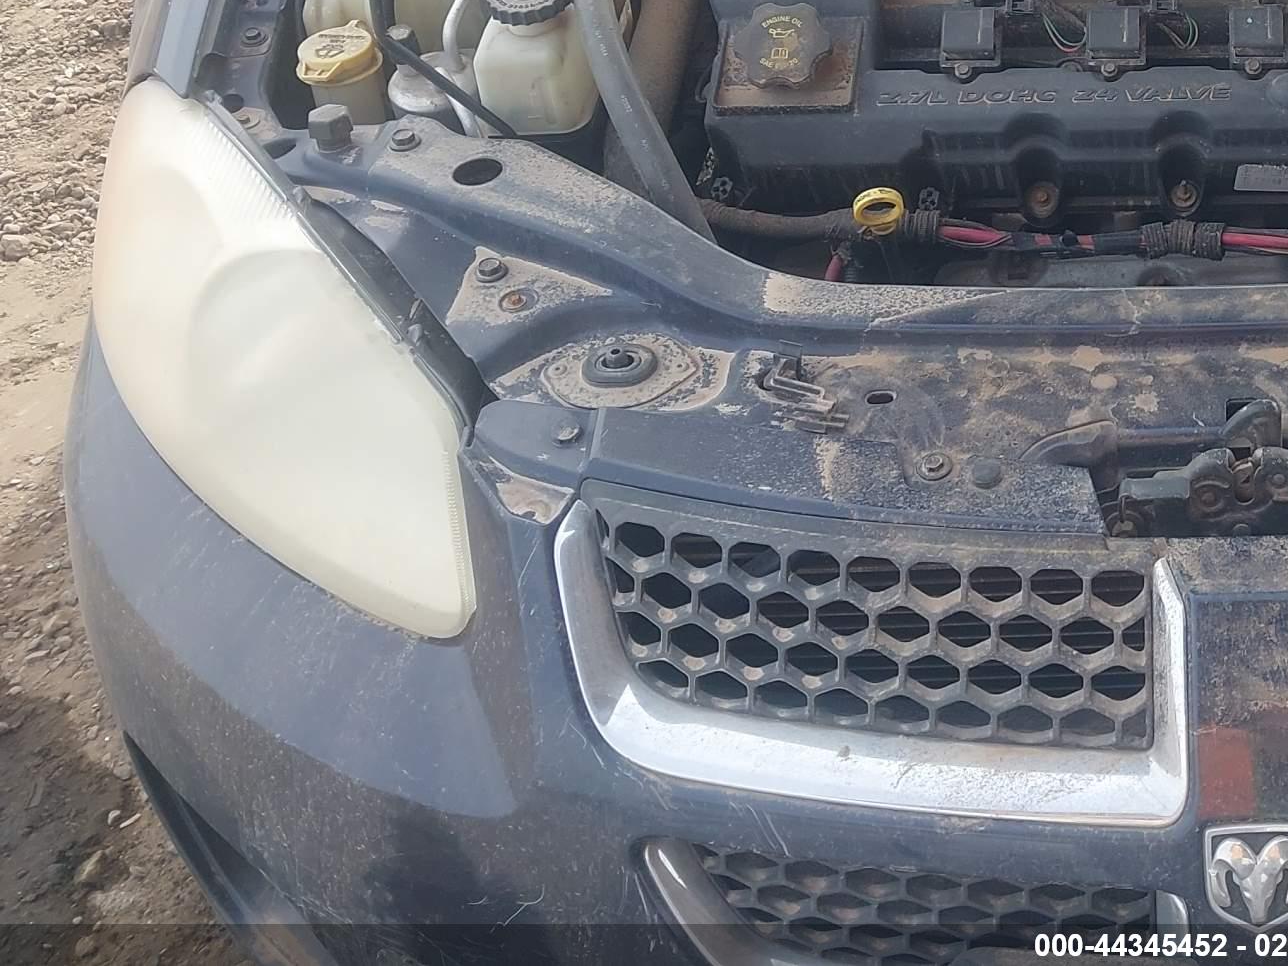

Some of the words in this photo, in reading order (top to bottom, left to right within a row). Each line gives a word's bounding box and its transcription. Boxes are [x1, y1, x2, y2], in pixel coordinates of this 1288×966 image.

[761, 15, 790, 28] ENGINE
[791, 17, 803, 28] OIL
[760, 57, 774, 68] SAE
[876, 90, 948, 106] 2.7L
[957, 89, 1057, 105] DOHC
[1072, 89, 1118, 103] 24
[1125, 83, 1232, 102] VALVE
